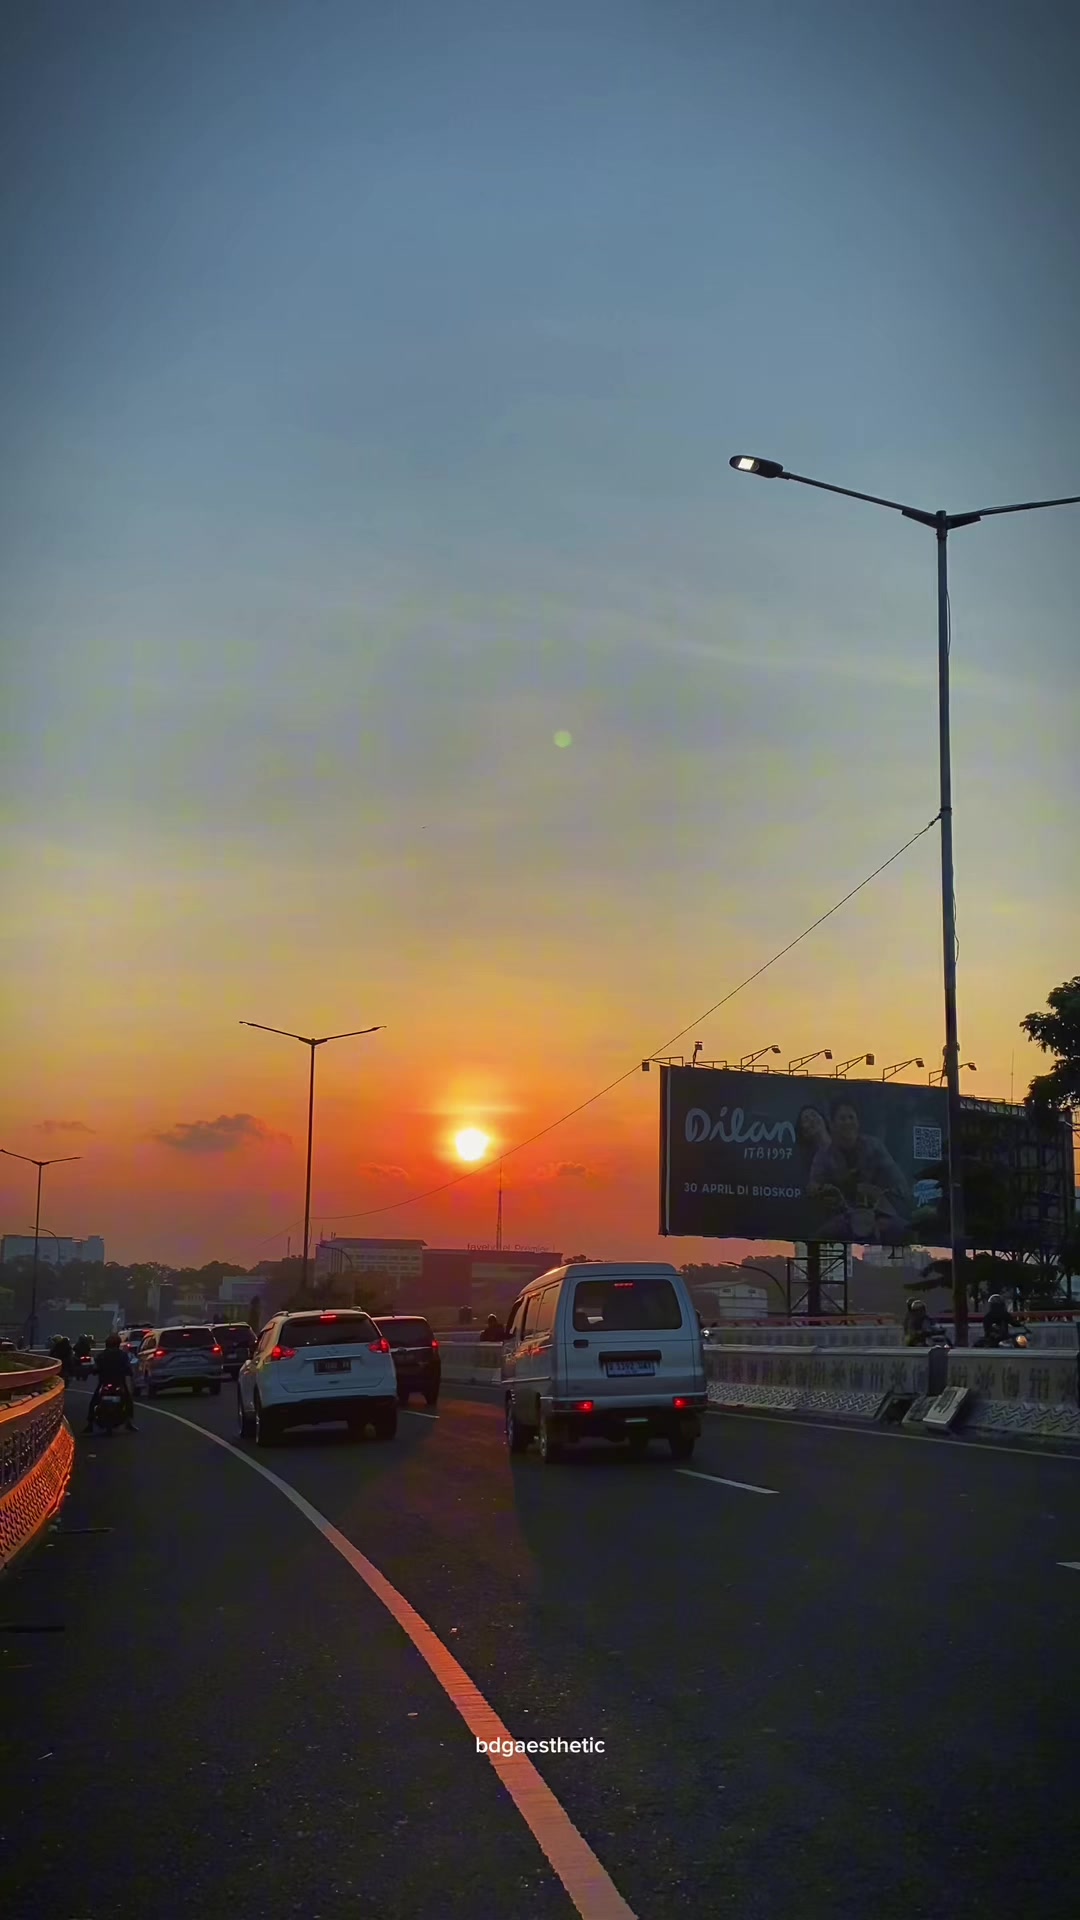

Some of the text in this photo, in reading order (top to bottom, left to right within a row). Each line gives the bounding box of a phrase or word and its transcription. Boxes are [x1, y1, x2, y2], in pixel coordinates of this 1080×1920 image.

[685, 1106, 796, 1143] Dilan
[743, 1147, 793, 1160] ITB 1997
[683, 1182, 801, 1198] 30 APRIL DI BIOSKOP
